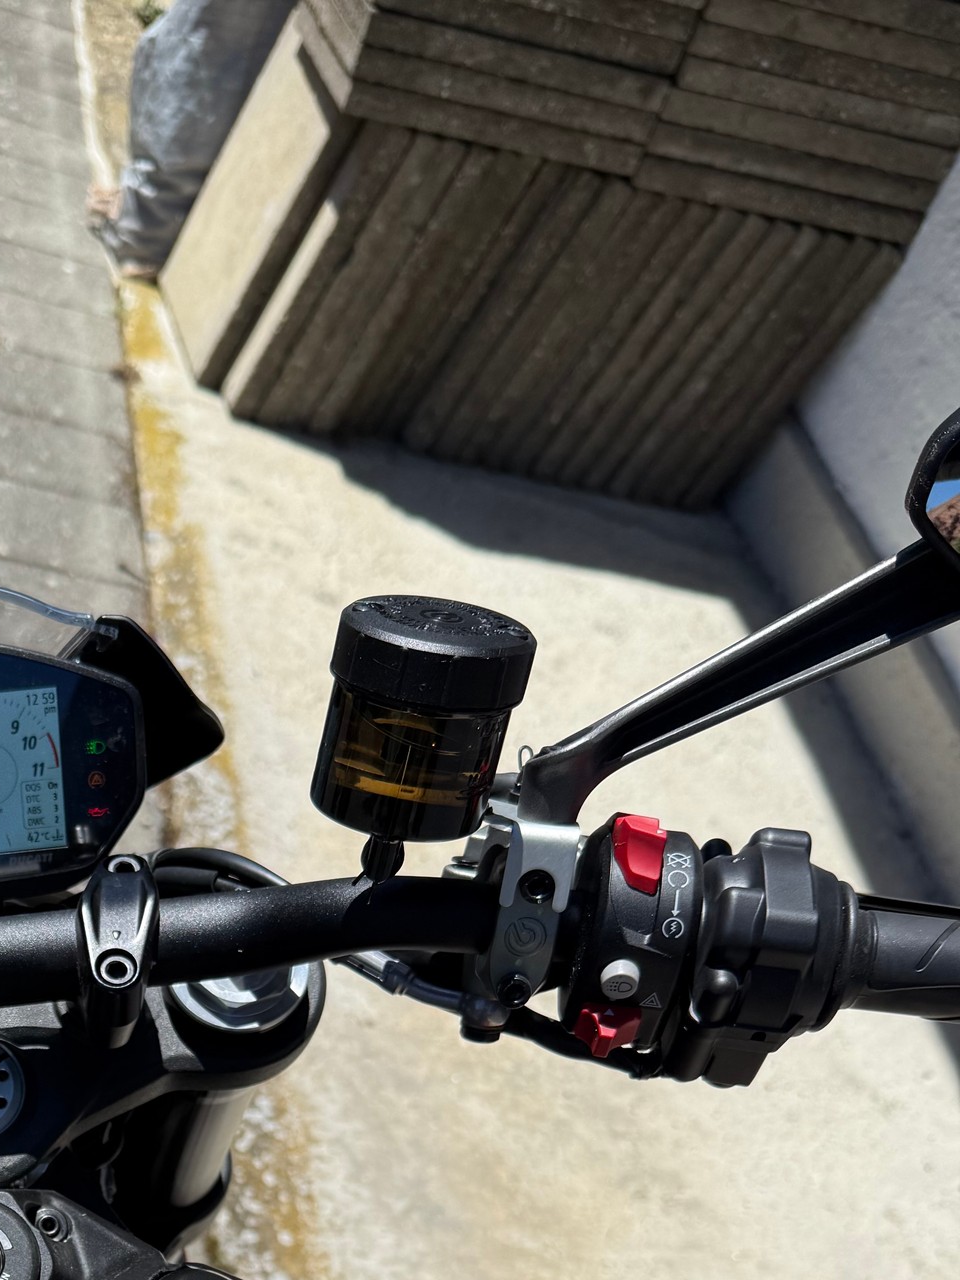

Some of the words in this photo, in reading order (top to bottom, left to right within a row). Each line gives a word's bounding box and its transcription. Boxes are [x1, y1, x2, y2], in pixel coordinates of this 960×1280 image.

[44, 706, 56, 717] pm
[10, 720, 20, 735] 9
[22, 735, 37, 750] 10
[32, 762, 45, 777] 11
[47, 782, 58, 790] On
[53, 793, 58, 801] 3
[27, 806, 42, 815] ABS
[54, 804, 59, 812] 3
[54, 815, 59, 824] 2
[9, 853, 53, 866] DUCATI
